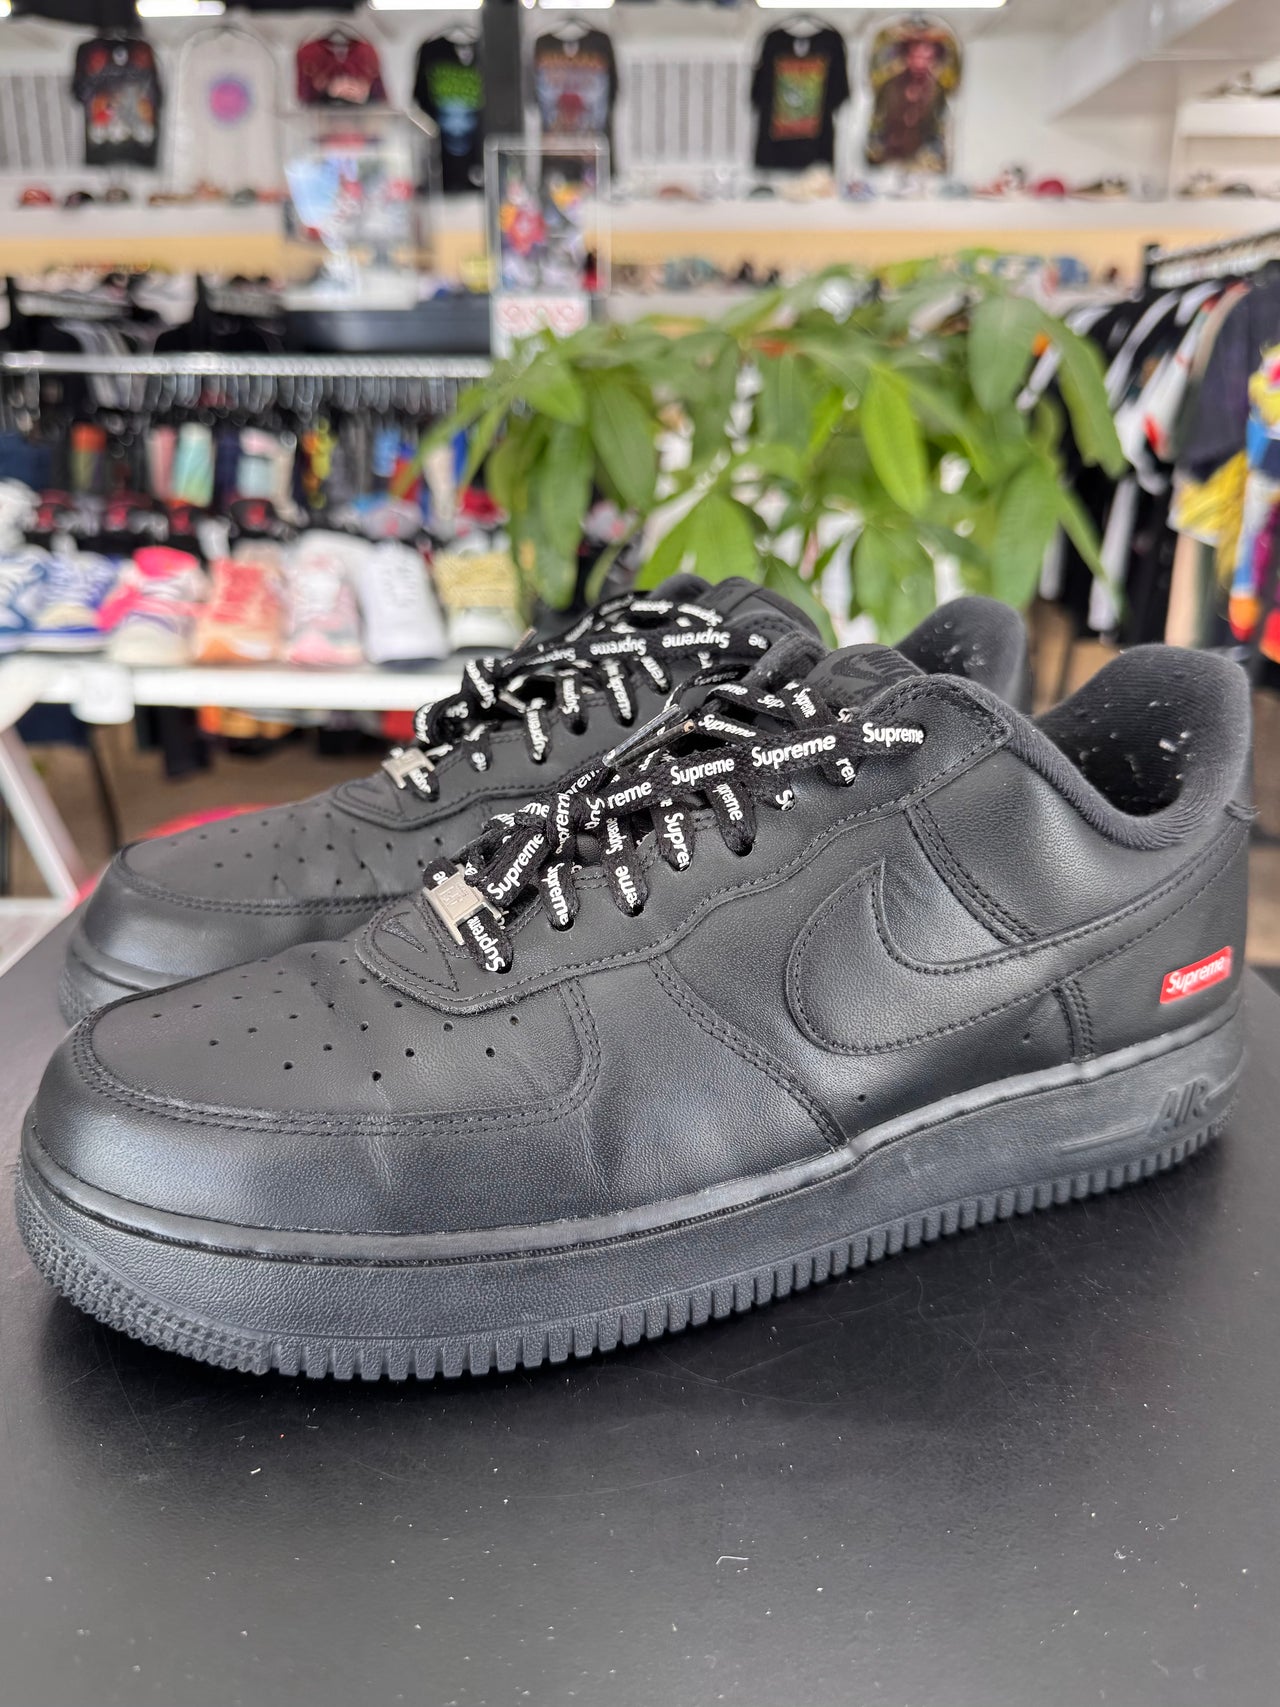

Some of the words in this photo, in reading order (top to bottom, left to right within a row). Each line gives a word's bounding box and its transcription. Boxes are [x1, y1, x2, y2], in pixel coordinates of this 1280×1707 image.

[589, 634, 647, 656] Supreme
[661, 627, 731, 649] Supreme
[698, 714, 757, 738] Supreme
[862, 723, 924, 747] Supreme
[751, 735, 836, 769] Supreme
[670, 757, 735, 786] Supreme
[487, 833, 545, 900] Supreme
[1166, 957, 1226, 993] Supreme
[1150, 1076, 1211, 1133] AIR
